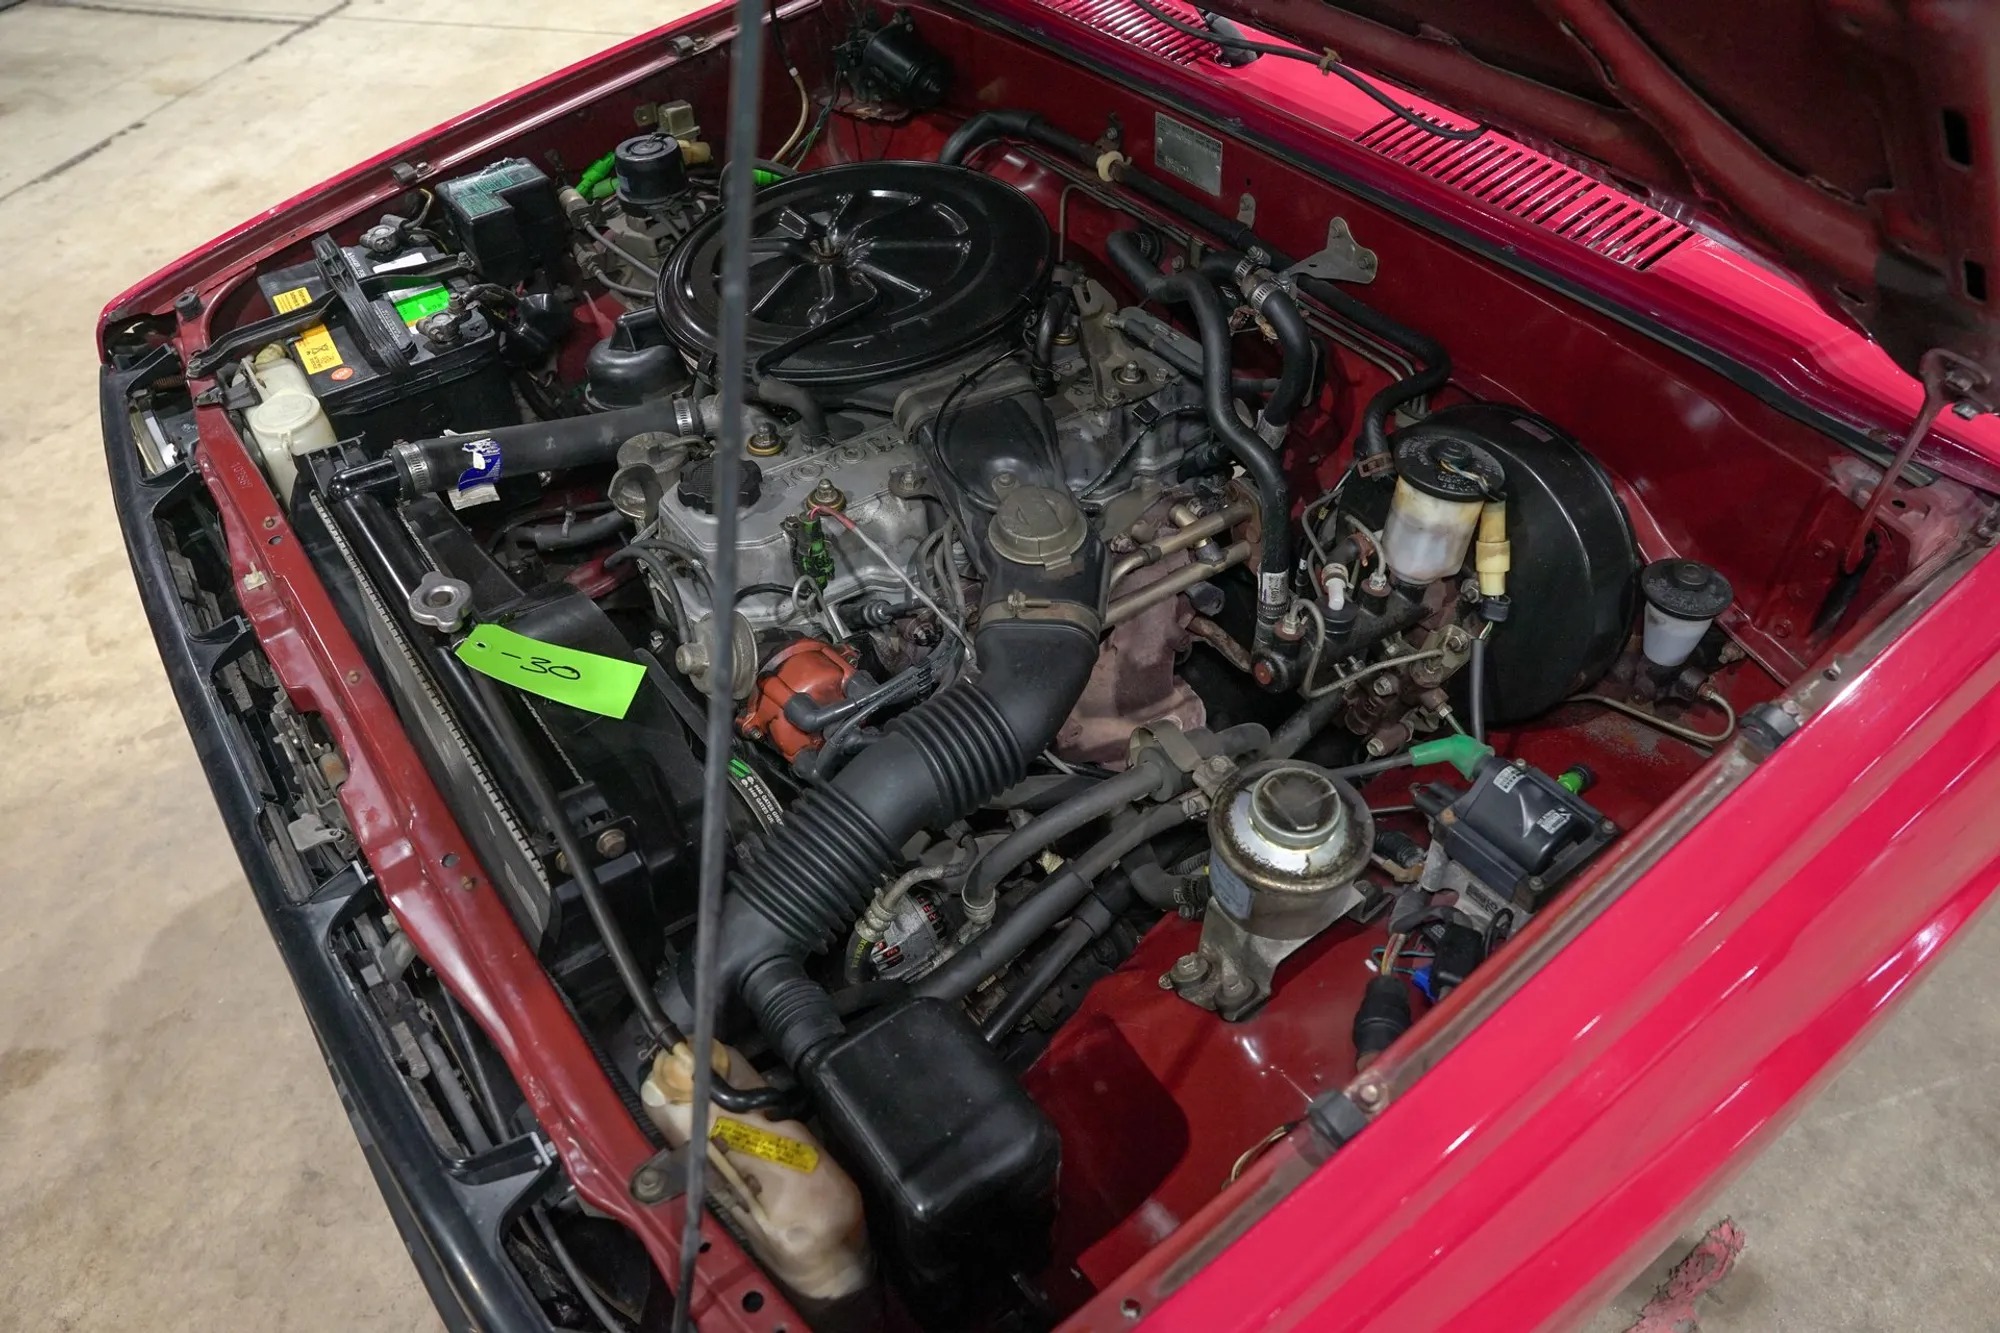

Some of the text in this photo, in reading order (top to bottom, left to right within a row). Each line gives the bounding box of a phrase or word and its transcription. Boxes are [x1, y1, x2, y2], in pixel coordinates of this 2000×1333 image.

[773, 429, 905, 491] TOYOTA
[755, 797, 769, 815] GATES
[761, 795, 775, 812] GATES
